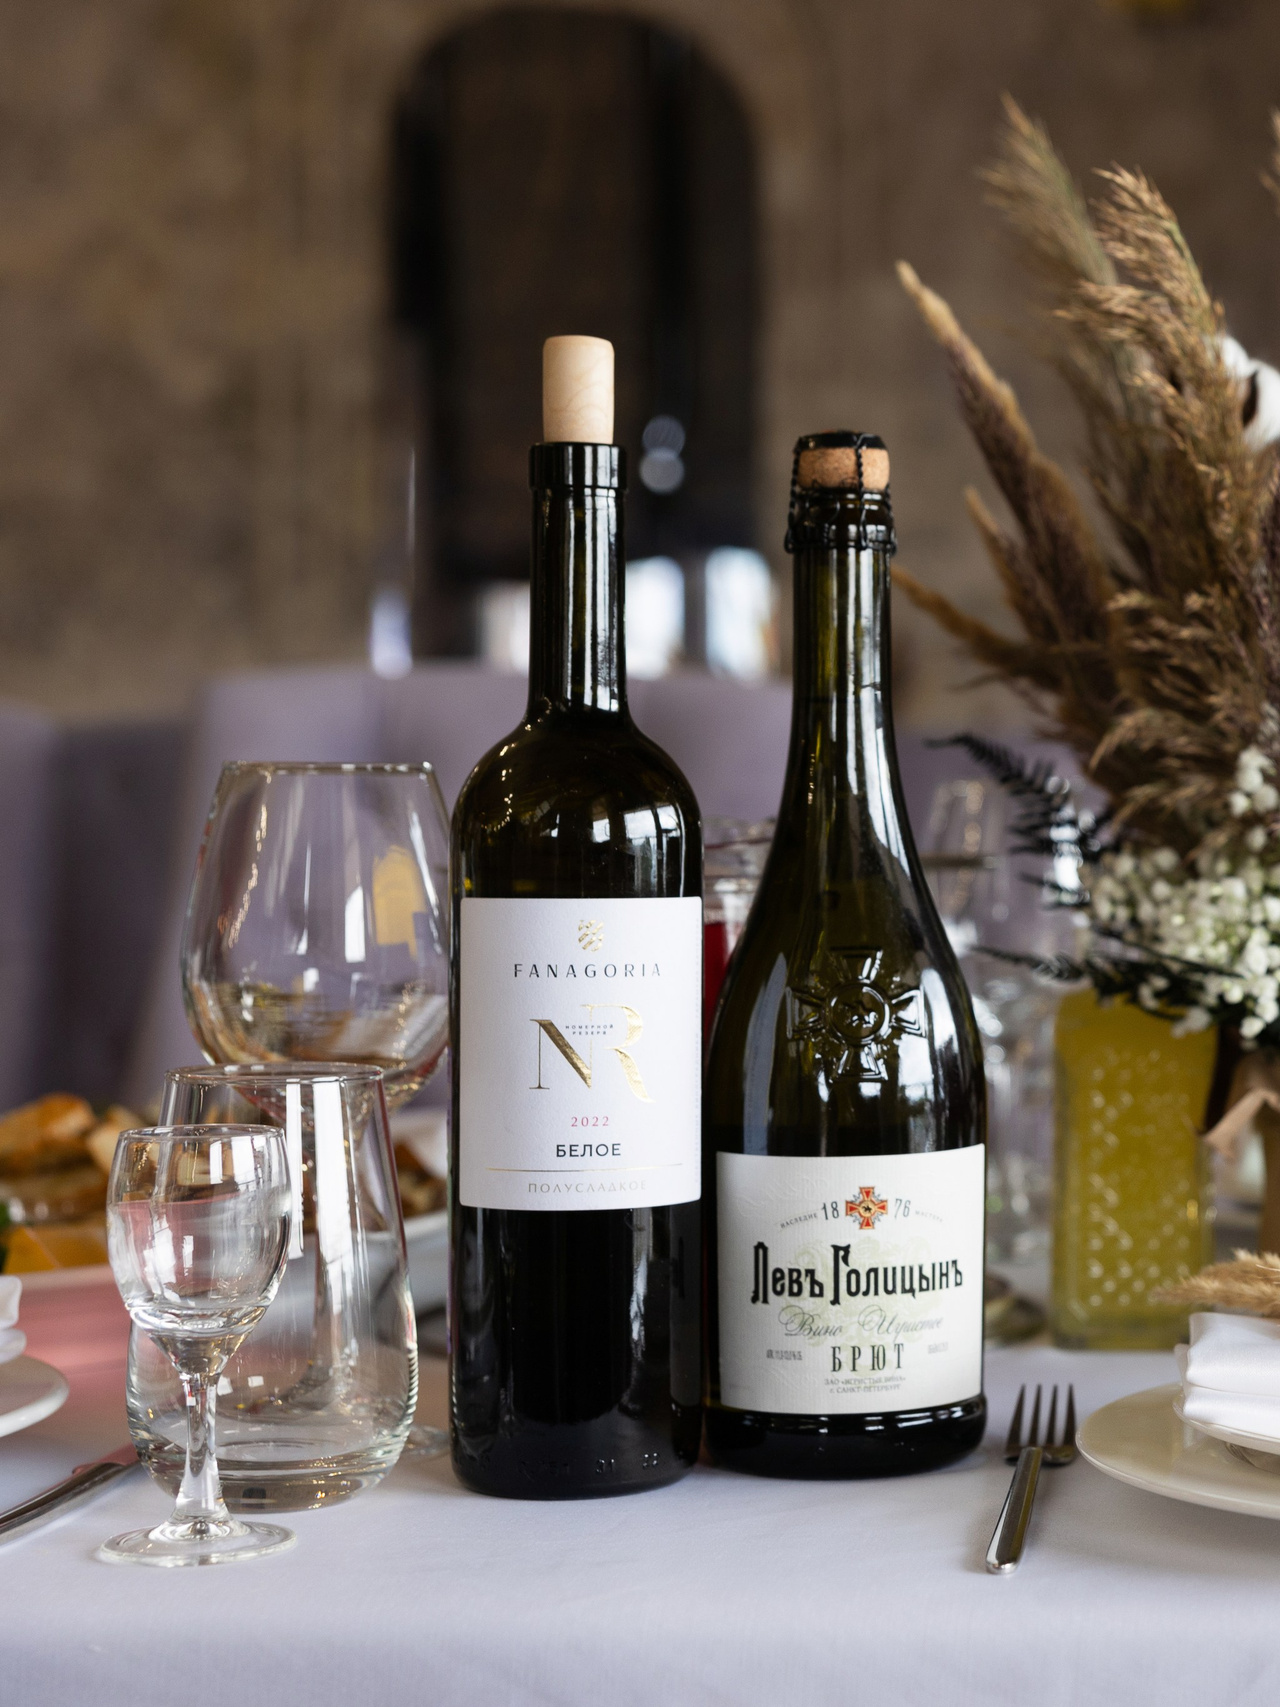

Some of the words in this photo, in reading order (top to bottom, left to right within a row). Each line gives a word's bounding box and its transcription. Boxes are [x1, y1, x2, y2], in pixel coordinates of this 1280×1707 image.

[514, 963, 661, 979] FANAGORIA
[571, 1116, 610, 1128] 2022
[556, 1143, 622, 1158] БЕЛОЕ
[528, 1180, 647, 1194] ПОЛУСЛАДКОЕ
[821, 1201, 840, 1220] 18
[894, 1198, 911, 1220] 76
[751, 1241, 824, 1304] Левъ
[830, 1243, 963, 1306] Голицынъ
[778, 1305, 843, 1337] Вино
[830, 1343, 905, 1373] БРЮТ
